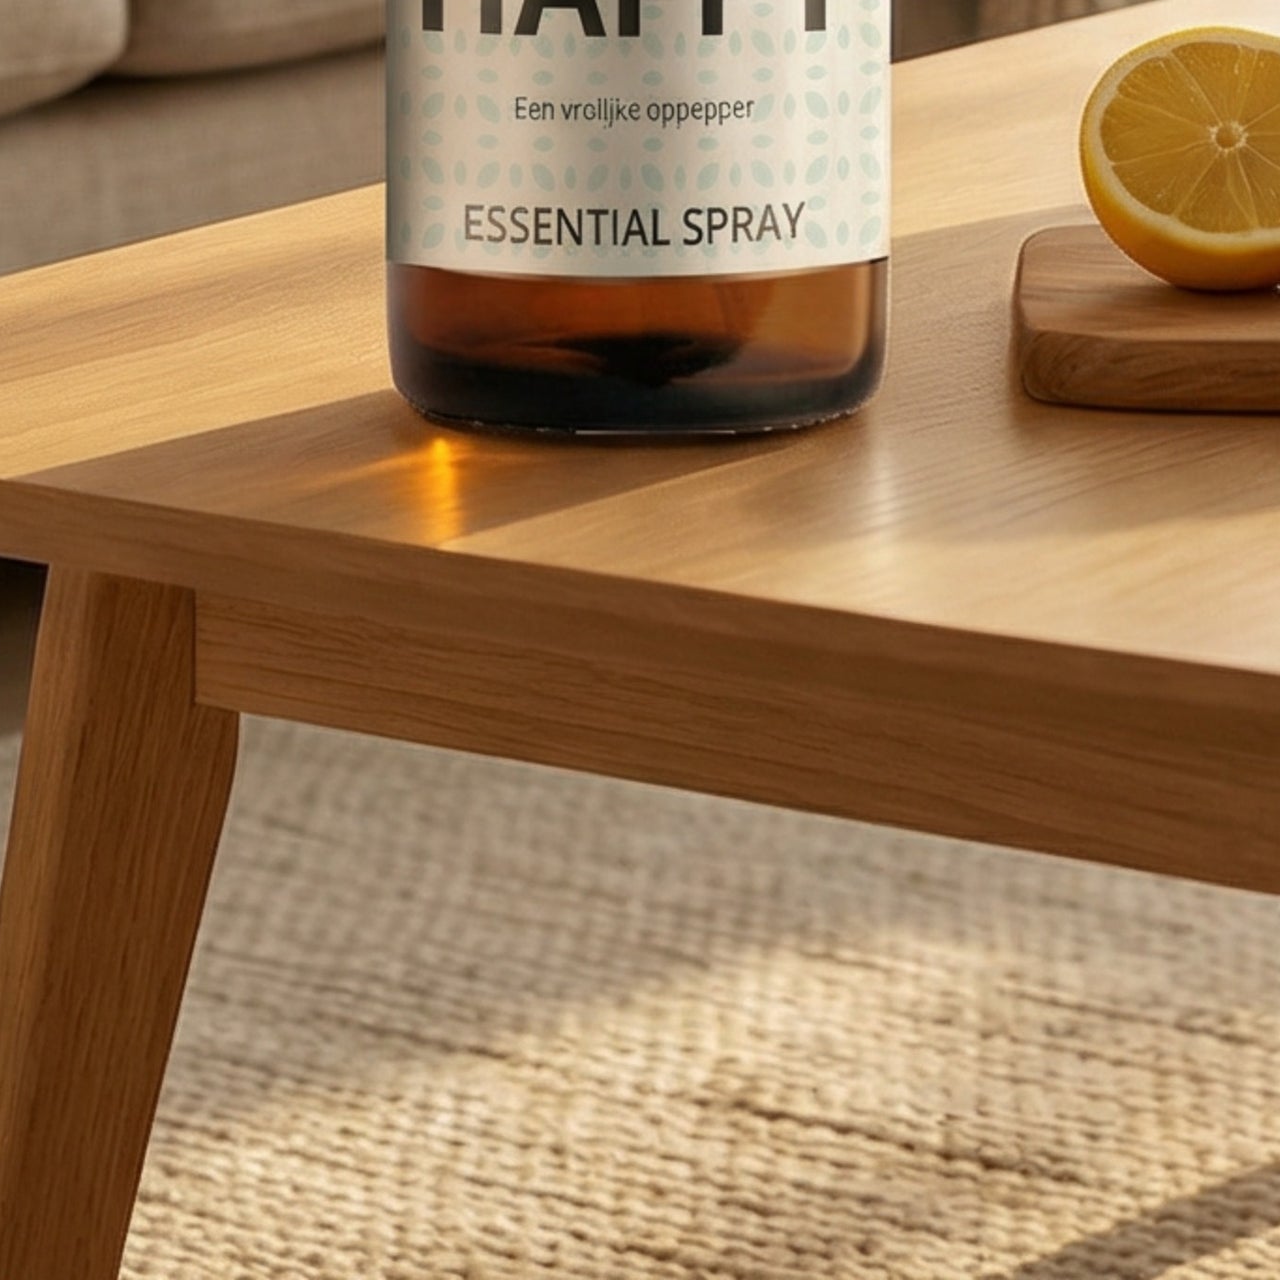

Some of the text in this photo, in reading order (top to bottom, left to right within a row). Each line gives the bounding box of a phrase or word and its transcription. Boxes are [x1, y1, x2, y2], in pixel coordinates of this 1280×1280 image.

[514, 96, 555, 121] Een
[464, 201, 806, 247] ESSENTIAL SPRAY
